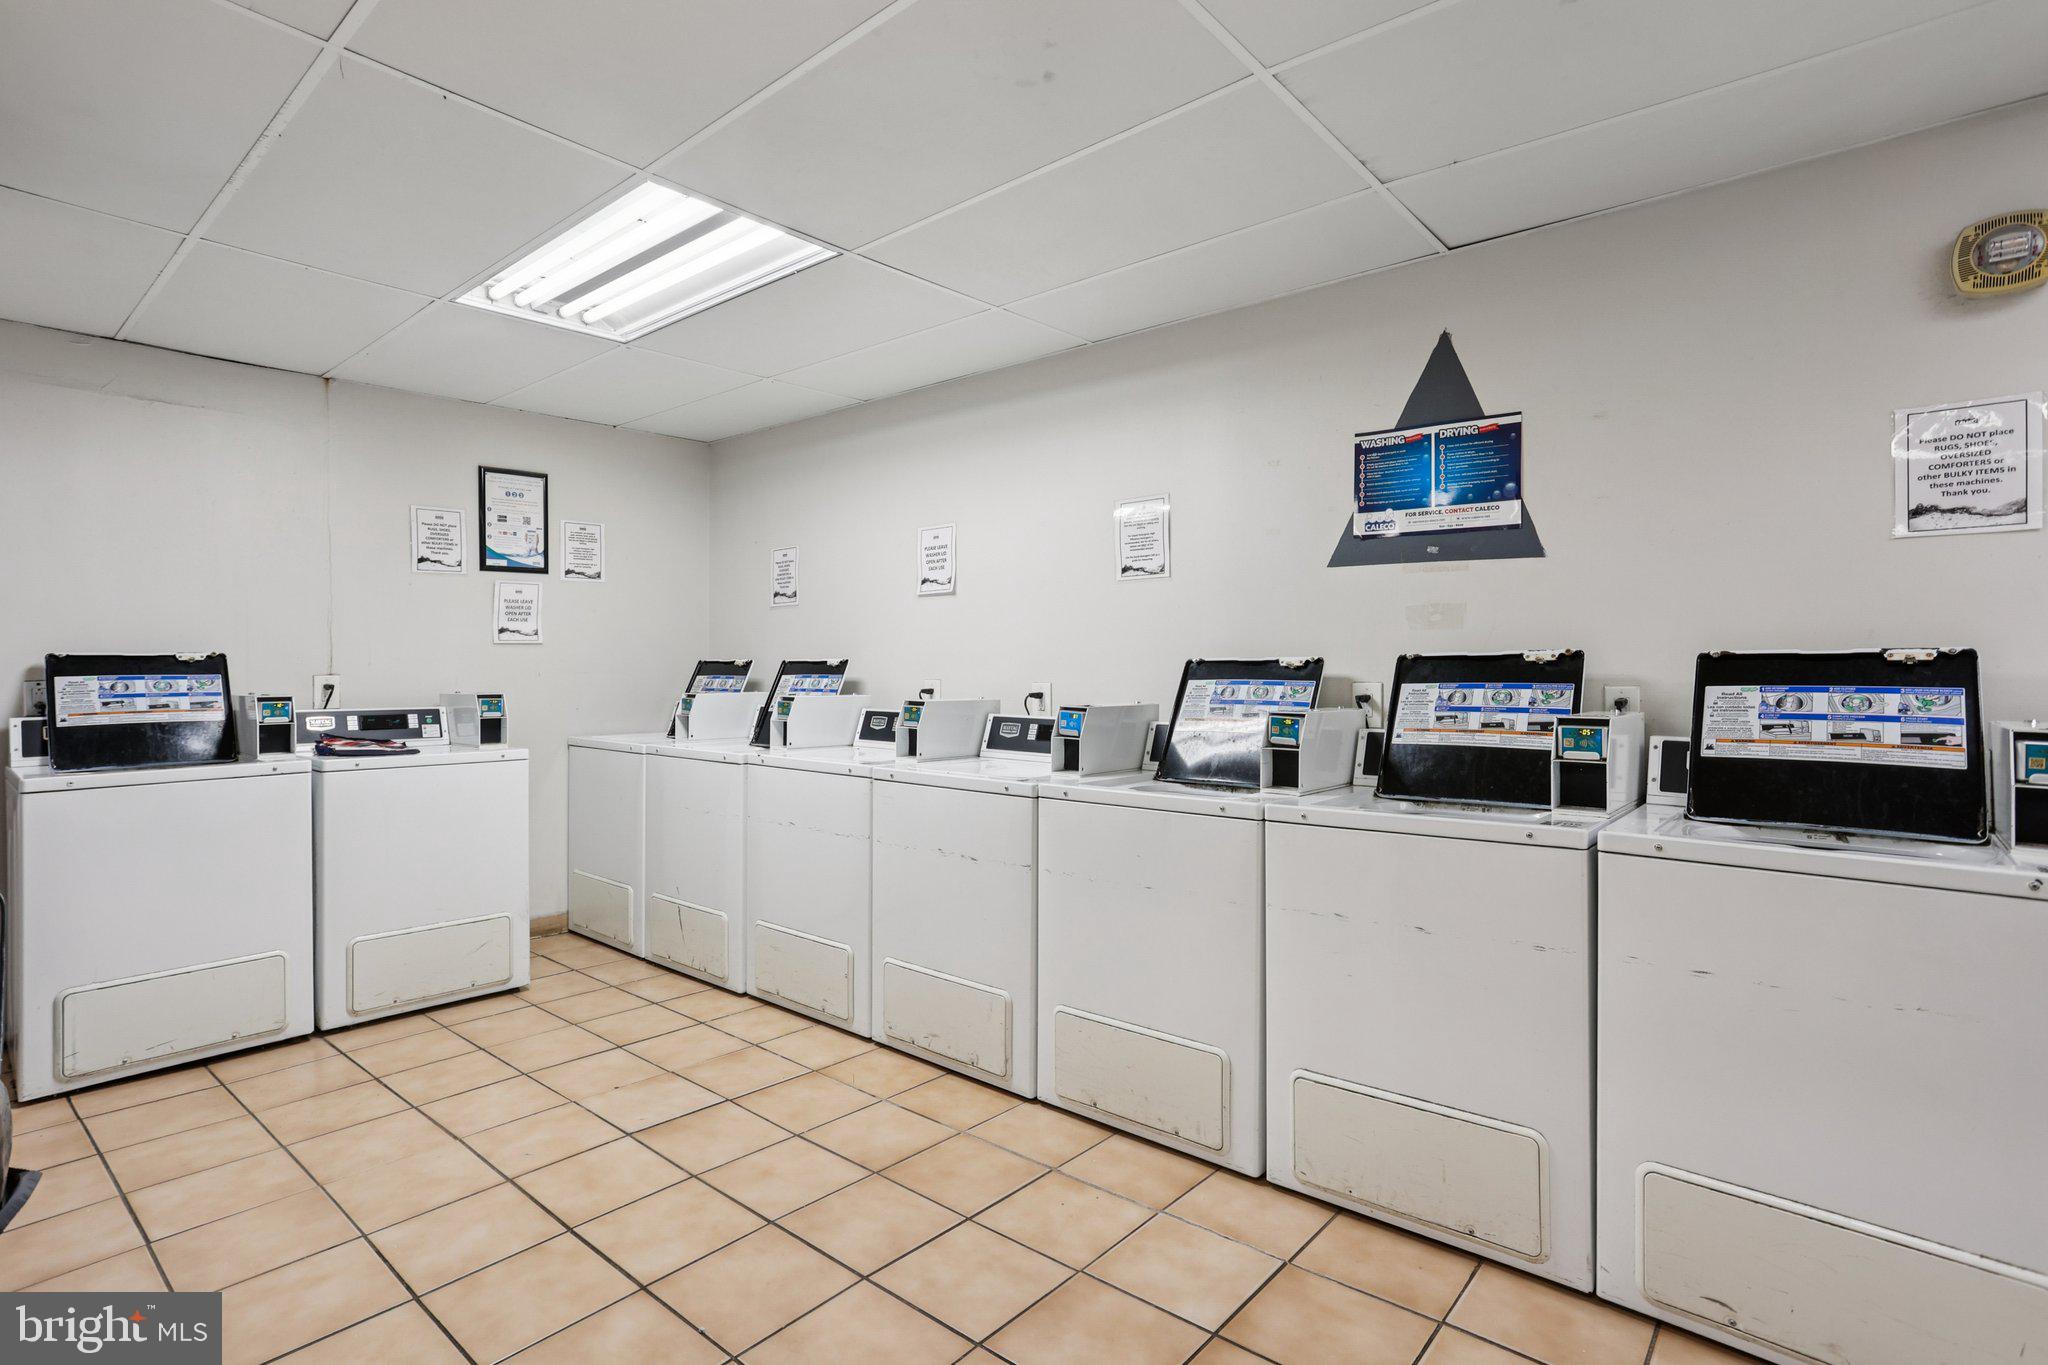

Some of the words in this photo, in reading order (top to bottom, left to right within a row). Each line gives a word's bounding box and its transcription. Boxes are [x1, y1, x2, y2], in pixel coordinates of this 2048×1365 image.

[1439, 426, 1478, 438] DRYING
[1966, 431, 1986, 439] NOT
[1989, 428, 2014, 438] place
[1360, 436, 1405, 449] WASHING
[1940, 450, 1992, 460] OVERSIZED
[1928, 459, 1992, 471] COMFORTERS
[1944, 470, 1973, 478] BULKY
[1976, 467, 2005, 475] ITEMS
[1956, 478, 2003, 487] machines.
[1940, 489, 1968, 497] Thank
[1970, 488, 1990, 496] you.
